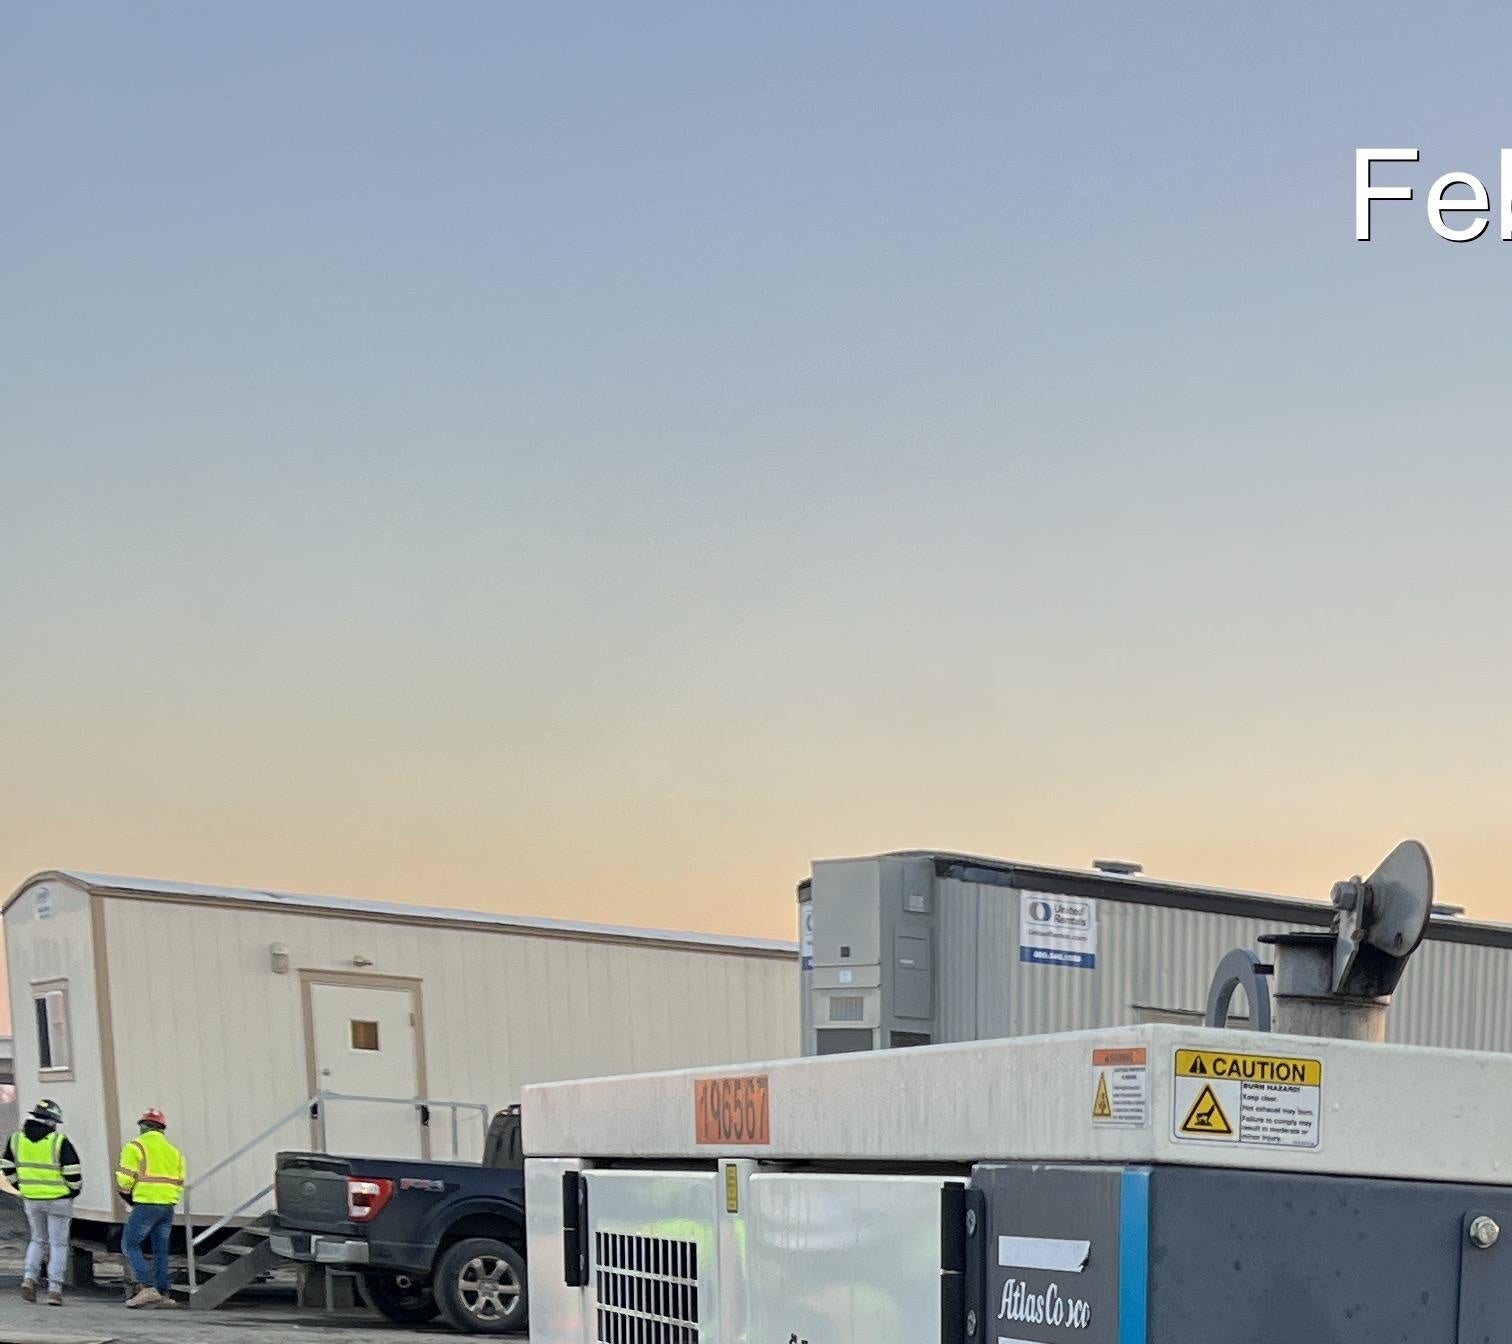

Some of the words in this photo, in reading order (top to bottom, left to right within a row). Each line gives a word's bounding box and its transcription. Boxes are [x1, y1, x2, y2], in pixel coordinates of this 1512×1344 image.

[1211, 1057, 1306, 1083] CAUTION
[700, 1077, 768, 1140] 196567
[997, 1278, 1044, 1324] Atlas
